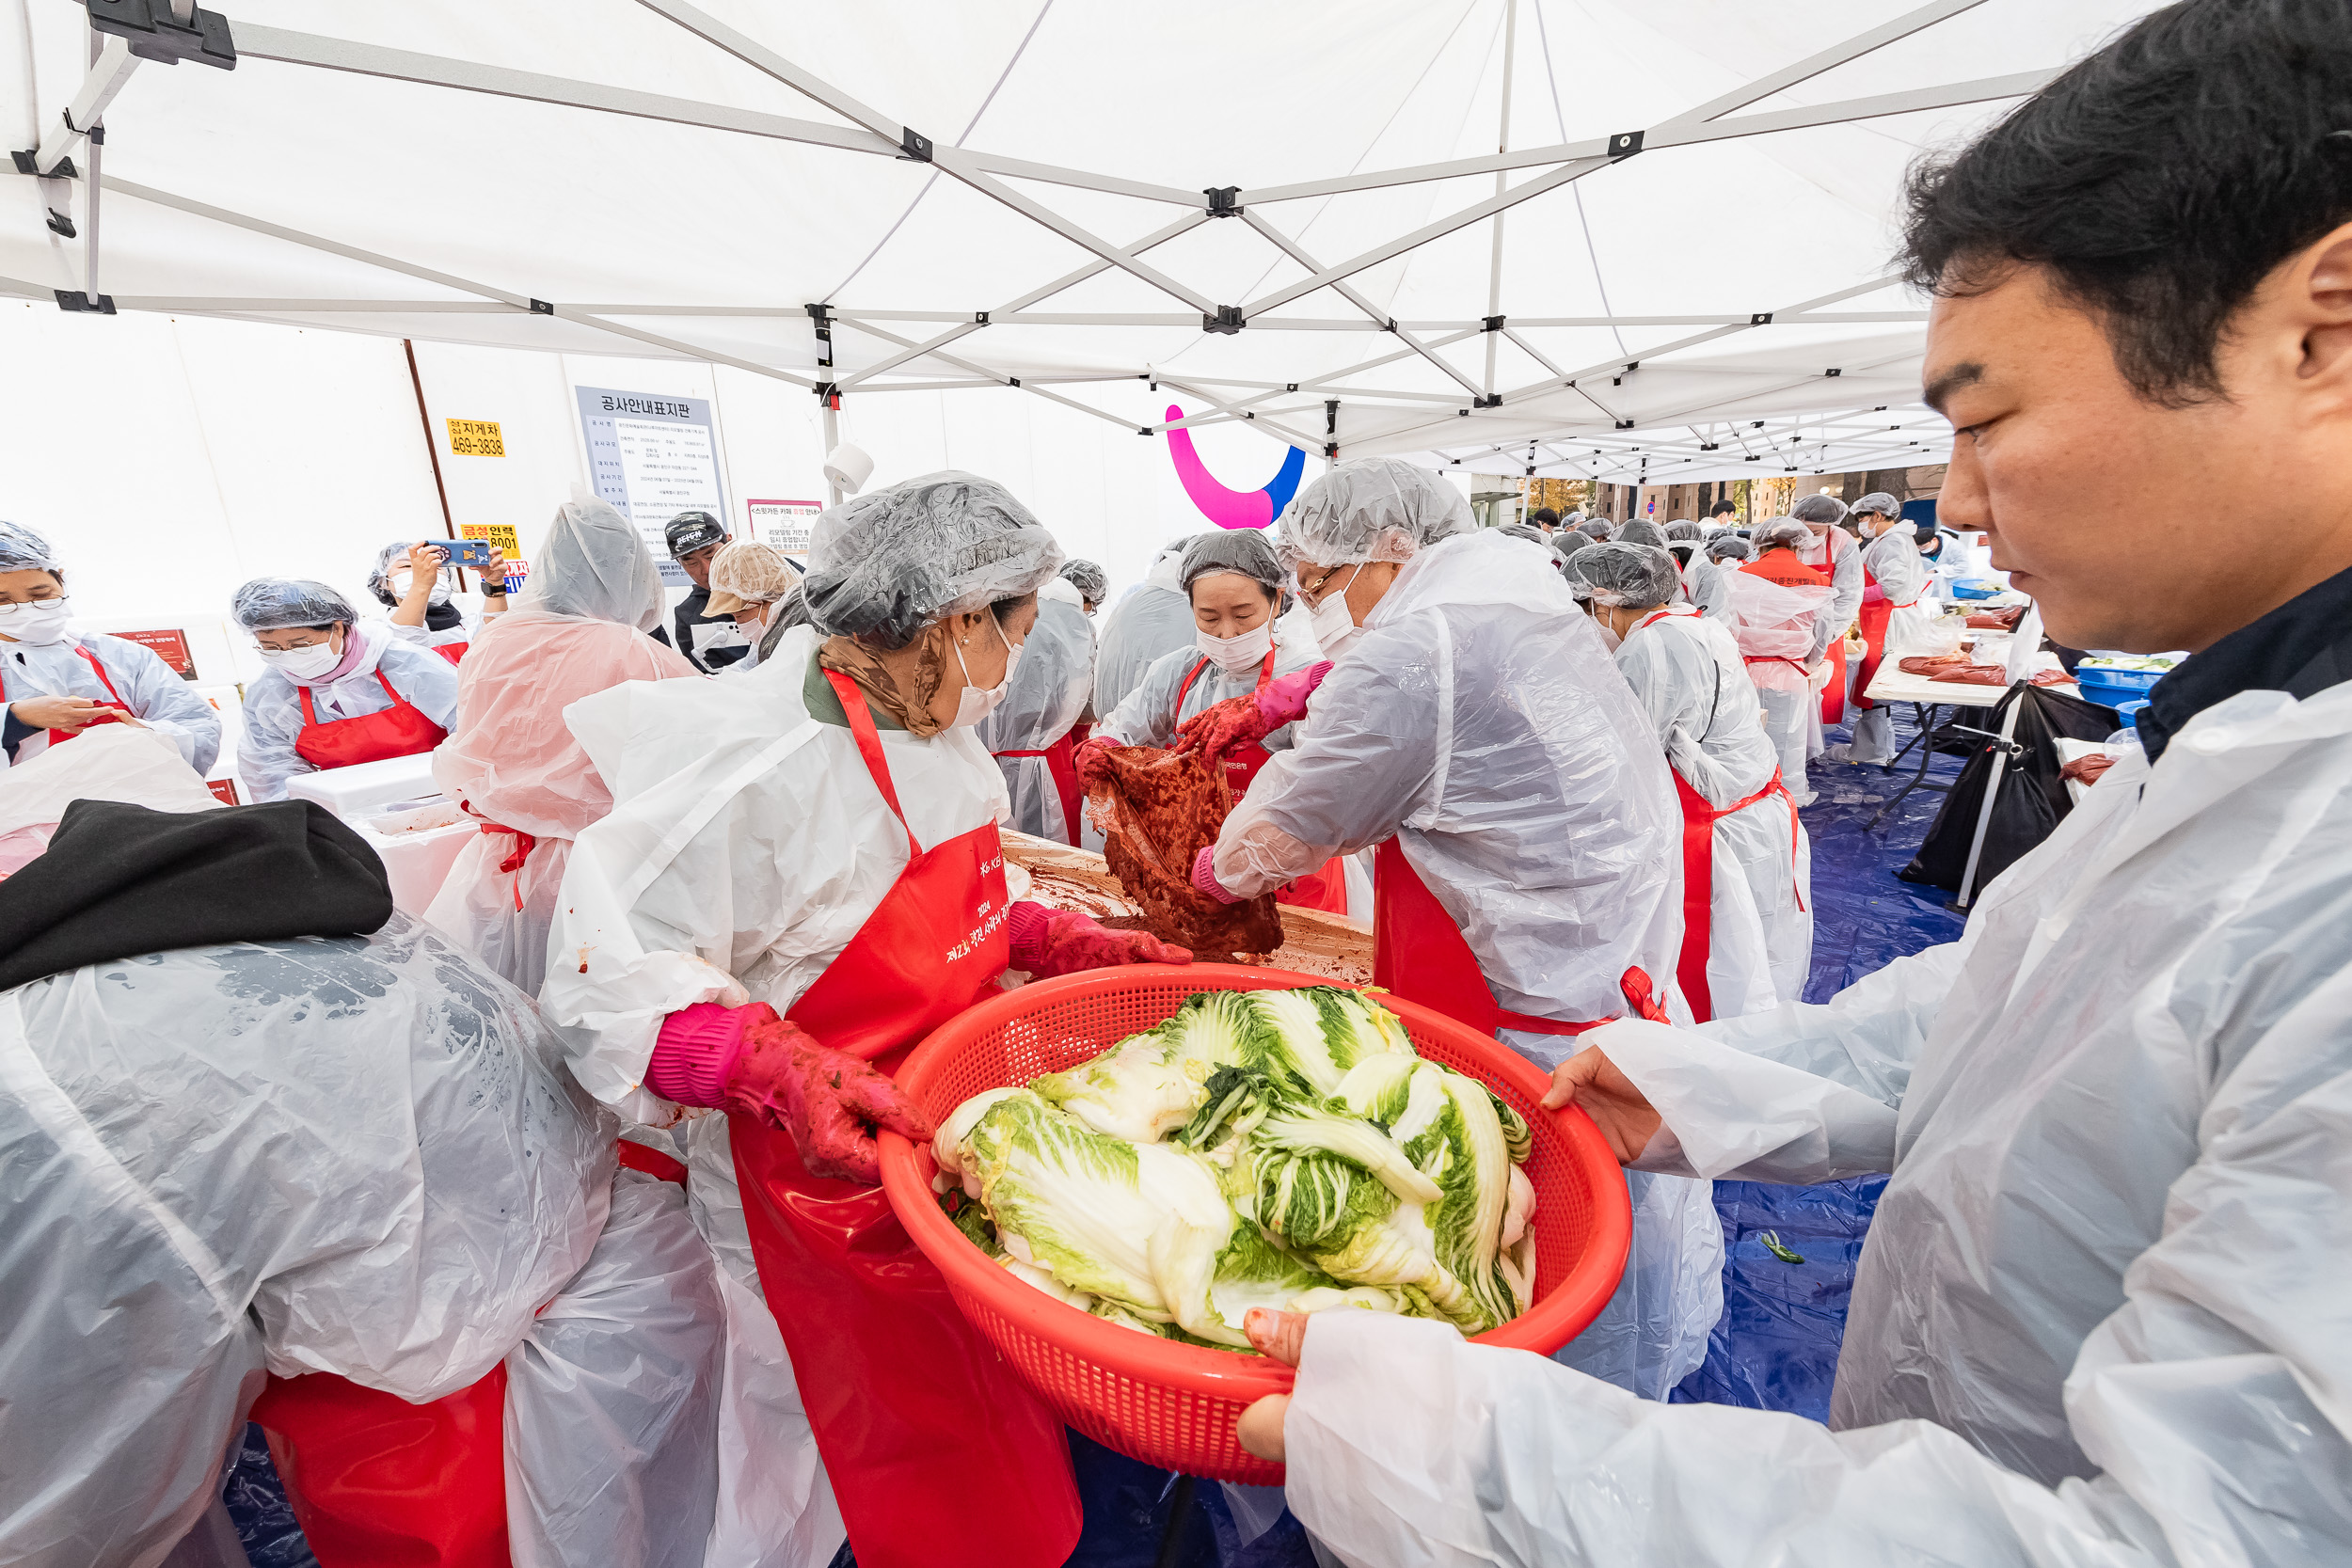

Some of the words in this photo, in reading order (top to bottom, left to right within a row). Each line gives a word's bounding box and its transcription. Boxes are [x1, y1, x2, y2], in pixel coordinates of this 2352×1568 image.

[601, 395, 691, 419] 공사안내표지판
[462, 422, 498, 437] 지게차
[453, 436, 503, 455] 469-3838
[780, 507, 792, 515] 카페
[464, 526, 514, 536] 금성인력
[977, 899, 992, 918] 2024
[946, 939, 971, 964] 제2회
